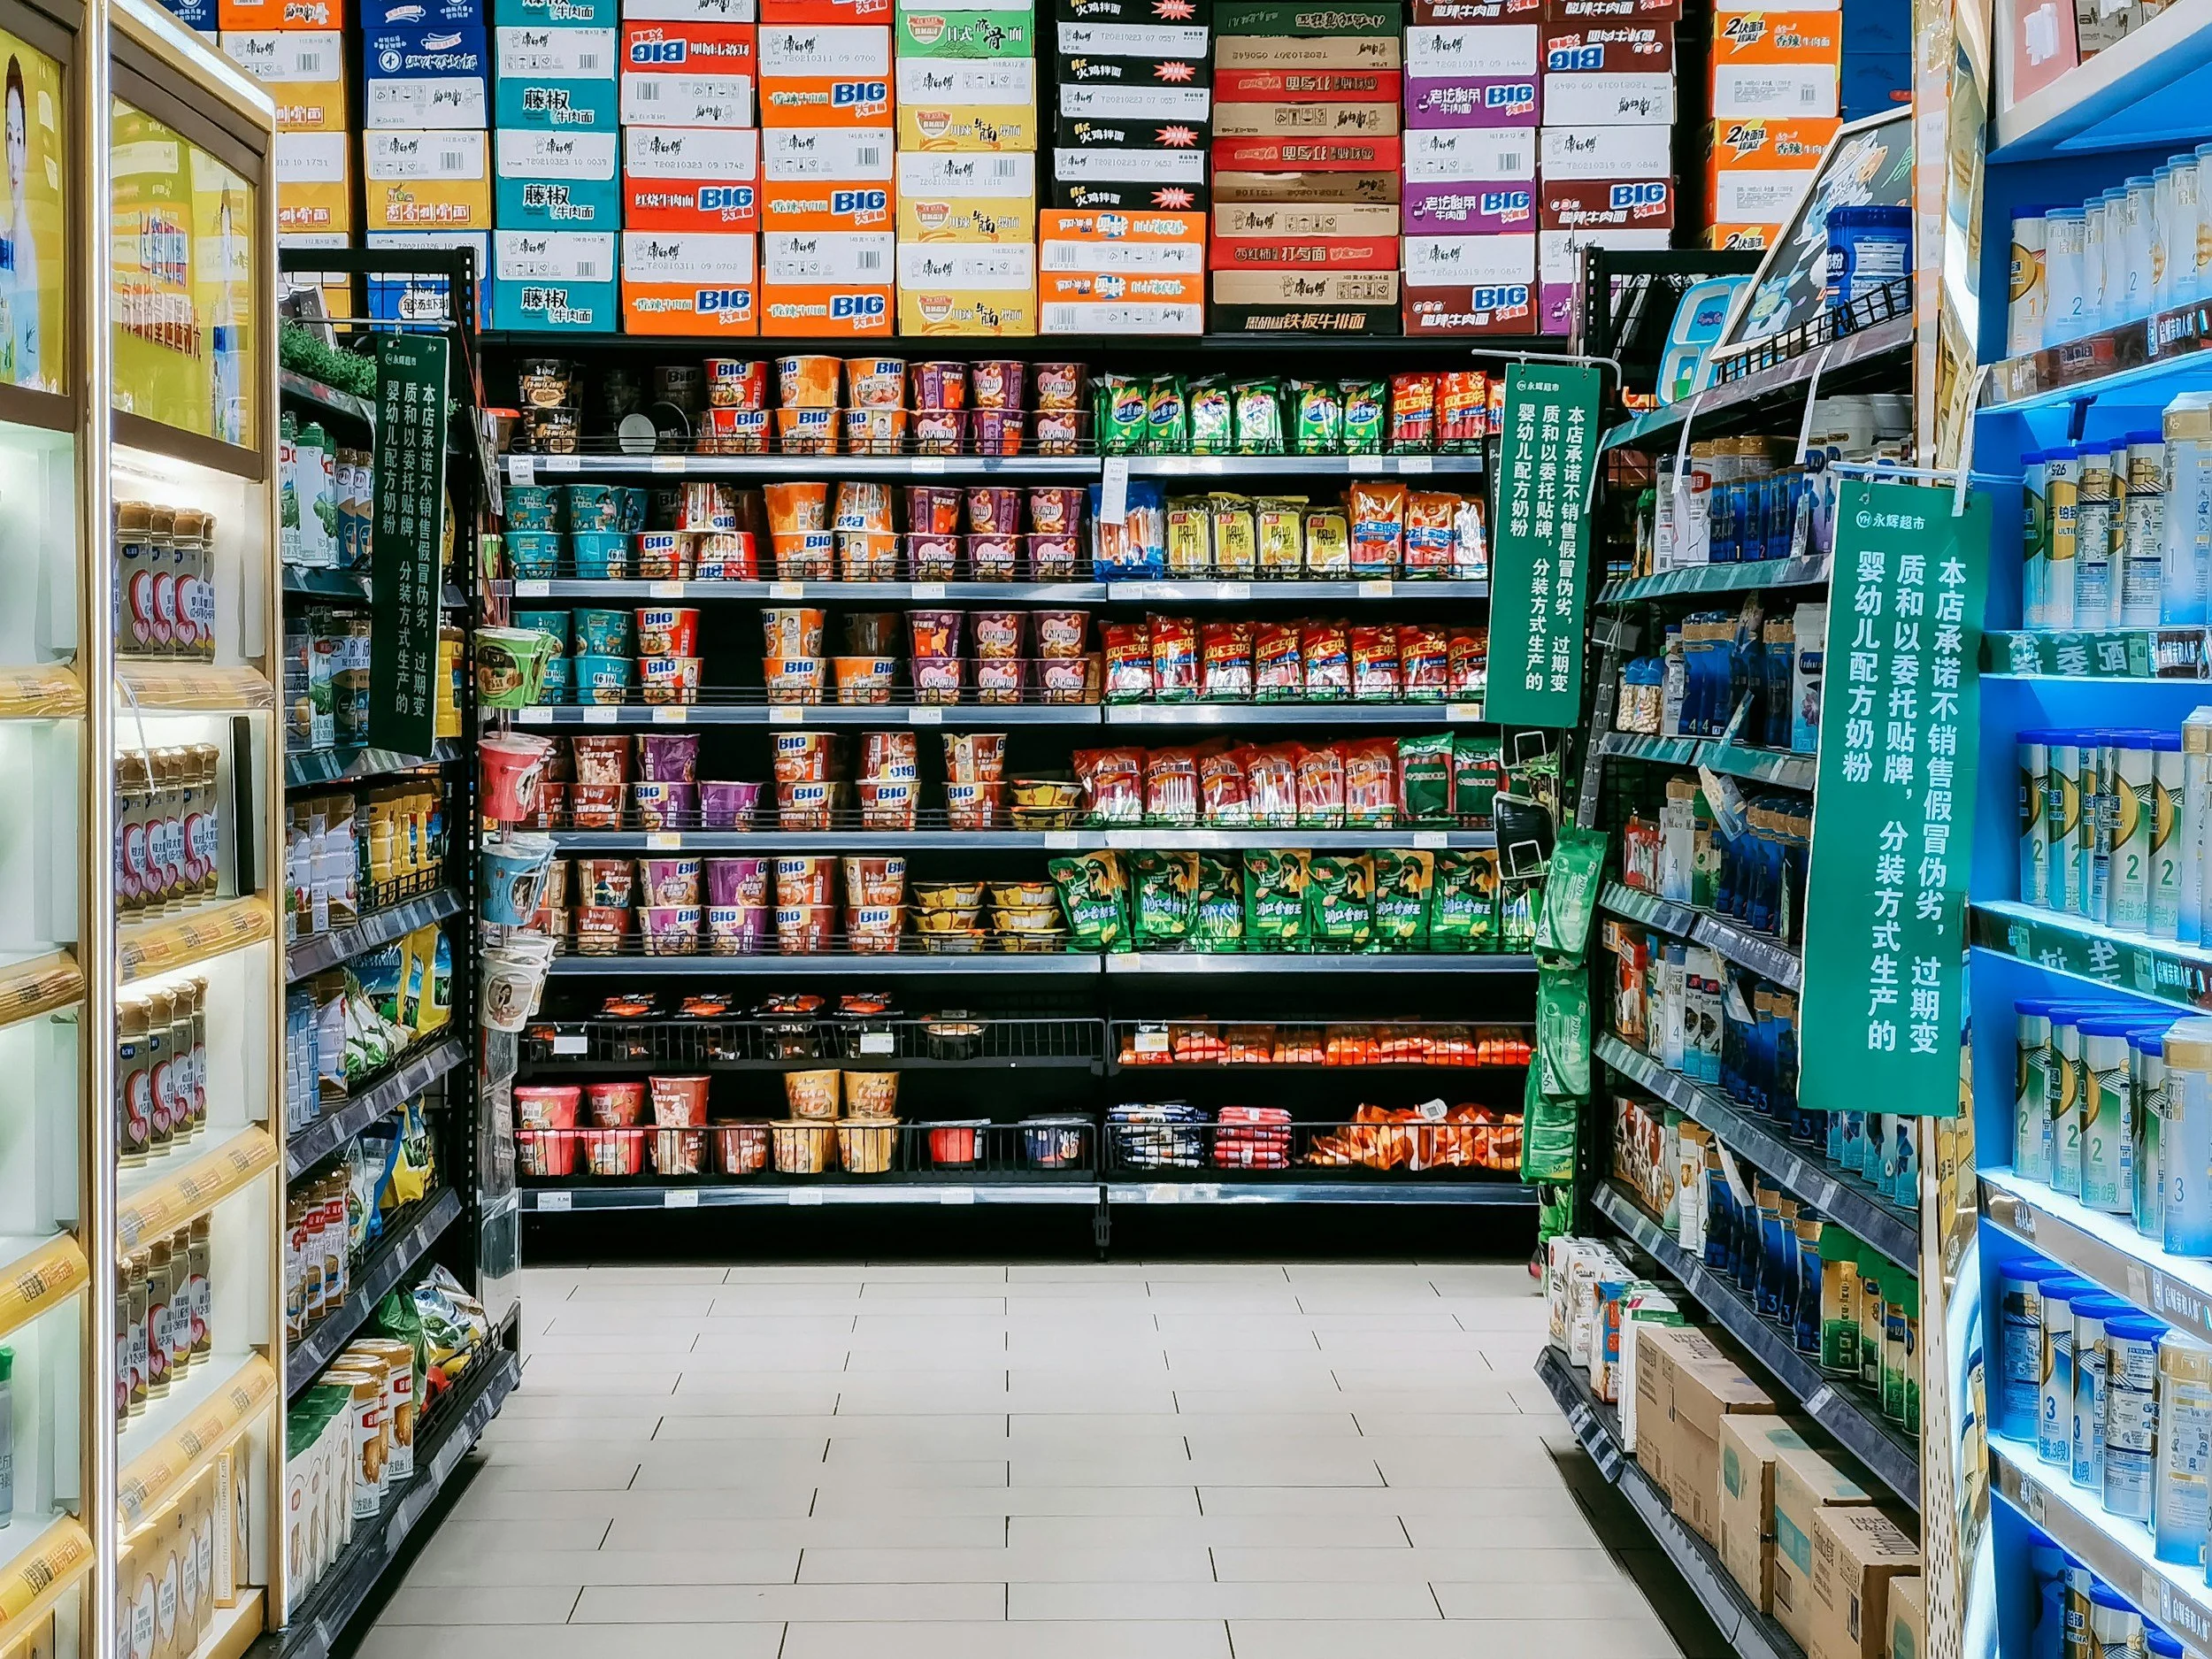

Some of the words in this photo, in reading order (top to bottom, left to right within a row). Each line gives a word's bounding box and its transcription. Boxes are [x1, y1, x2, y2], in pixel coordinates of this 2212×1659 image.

[557, 6, 593, 19] 牛肉面
[1077, 2, 1122, 18] 火鸡拌面
[1432, 4, 1501, 18] 酸辣牛肉面
[1564, 1, 1632, 16] 酸辣牛肉面
[947, 18, 1023, 50] 日式豚骨面
[632, 40, 685, 63] BIG
[1549, 44, 1603, 71] BIG
[1078, 64, 1122, 80] 火鸡拌面
[523, 88, 569, 111] 藤椒
[833, 82, 886, 106] BIG
[1429, 87, 1481, 104] 老坛酸菜
[1486, 84, 1534, 107] BIG
[557, 111, 593, 123] 牛肉面
[1439, 103, 1472, 115] 牛肉面
[1079, 128, 1125, 143] 火鸡拌面
[523, 184, 569, 206] 藤椒
[634, 194, 694, 208] 红烧牛肉面
[699, 188, 754, 211] BIG
[831, 190, 886, 214] BIG
[1076, 192, 1121, 207] 火鸡拌面
[1425, 196, 1476, 211] 老坛酸菜
[1482, 191, 1530, 214] BIG
[1610, 183, 1666, 208] BIG
[557, 207, 593, 219] 牛肉面
[1434, 209, 1468, 221] 牛肉面
[1558, 211, 1628, 226] 酸辣牛肉面
[2130, 272, 2138, 291] 2
[520, 287, 568, 310] 藤椒
[698, 289, 750, 312] BIG
[831, 293, 885, 319] BIG
[1473, 285, 1528, 310] BIG
[2071, 296, 2083, 316] 2
[553, 310, 591, 322] 牛肉面
[1246, 311, 1367, 330] 黑胡椒铁板牛排面
[1420, 312, 1489, 326] 酸辣牛肉面
[717, 361, 747, 376] BIG
[1527, 382, 1559, 393] 永辉超市
[736, 411, 764, 426] BIG
[799, 411, 828, 425] BIG
[381, 379, 399, 534] 婴幼儿配方奶粉
[1509, 403, 1536, 537] 婴幼儿配方奶粉
[1858, 515, 1870, 526] YH
[1873, 513, 1925, 531] 永辉超市
[395, 381, 418, 714] 质和以委托贴牌，分装方式生产的
[412, 382, 436, 718] 本店承诺不销售假冒伪劣，过期变
[644, 536, 673, 550] BIG
[1525, 404, 1560, 691] 质和以委托贴牌，分装方式生产的
[1550, 407, 1586, 692] 本店承诺不销售假冒伪劣，过期变
[644, 612, 673, 626] BIG
[648, 661, 676, 674] BIG
[785, 661, 814, 673] BIG
[1841, 549, 1886, 782] 婴幼儿配方奶粉
[1689, 718, 1697, 733] 4
[1701, 718, 1709, 733] 4
[779, 737, 806, 750] BIG
[637, 787, 659, 798] BIG
[794, 786, 824, 801] BIG
[878, 786, 908, 801] BIG
[949, 786, 974, 799] BIG
[1868, 554, 1927, 1052] 质和以委托贴牌，分装方式生产的
[1909, 556, 1966, 1055] 本店承诺不销售假冒伪劣，过期变
[2032, 838, 2044, 864] 2
[779, 861, 805, 874] BIG
[2125, 853, 2139, 880] 2
[2162, 859, 2174, 886] 2
[710, 910, 736, 923] BIG
[777, 910, 801, 924] BIG
[860, 910, 889, 923] BIG
[2018, 1110, 2029, 1135] 2
[2067, 1123, 2079, 1148] 2
[2091, 1137, 2103, 1163] 2
[2174, 1176, 2184, 1202] 3
[2046, 1395, 2056, 1421] 3
